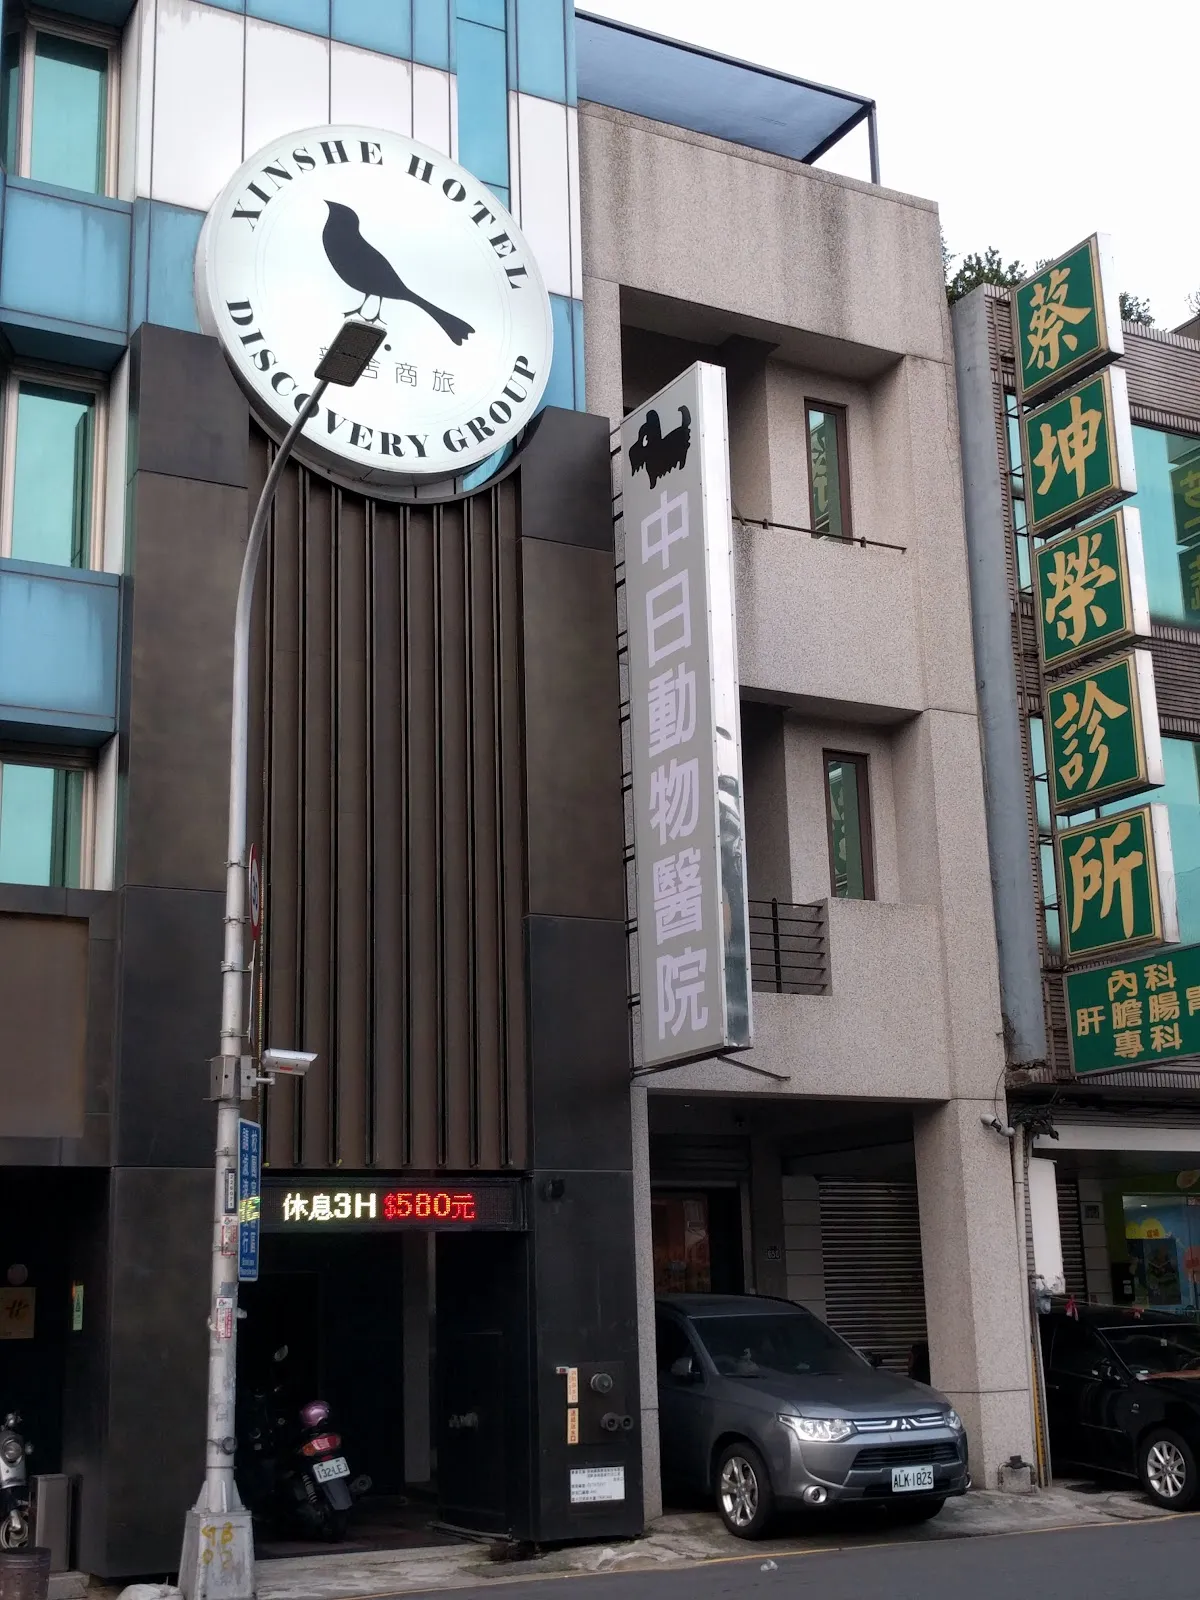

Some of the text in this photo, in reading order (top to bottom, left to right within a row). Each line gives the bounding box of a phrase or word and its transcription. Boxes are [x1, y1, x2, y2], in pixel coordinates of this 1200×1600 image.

[231, 140, 529, 290] XINSHE HOTEL
[226, 298, 537, 459] DISCOVERY GROUP
[318, 346, 456, 395] 舍商旅
[1025, 267, 1144, 939] 蔡坤榮診所
[640, 489, 709, 1041] 中日動物醫院
[1107, 960, 1178, 1002] 內科
[1113, 1022, 1183, 1059] 專科
[282, 1192, 377, 1221] 休息3H
[383, 1192, 476, 1220] $580元
[894, 1471, 933, 1488] ALK-1823
